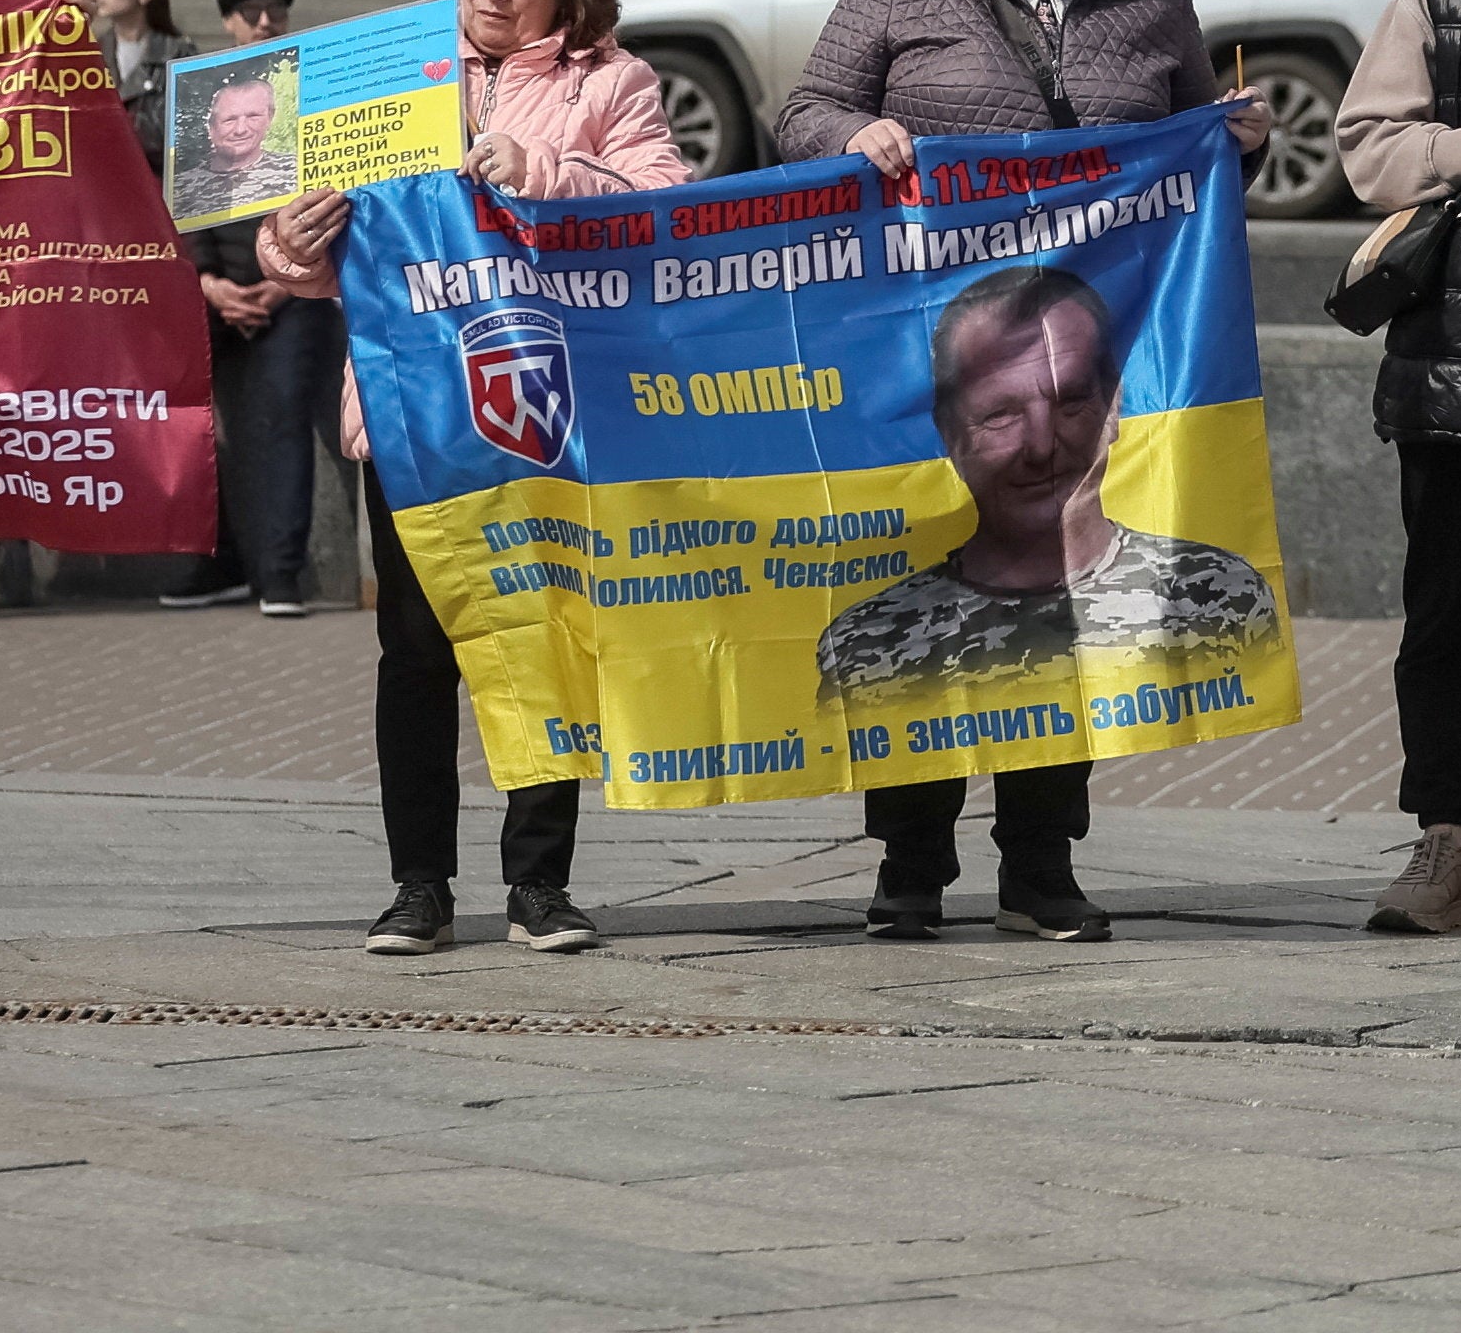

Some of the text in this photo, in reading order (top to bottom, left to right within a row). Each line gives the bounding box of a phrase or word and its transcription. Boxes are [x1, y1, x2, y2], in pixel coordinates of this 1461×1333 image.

[303, 101, 411, 136] 58 ОМПБр
[303, 119, 404, 151] Матюшко
[302, 145, 439, 181] Михайлович
[303, 134, 388, 166] Валерій
[670, 177, 862, 241] зниклий
[403, 170, 1197, 315] Матюшко Валерій Михайлович
[70, 286, 84, 303] 2
[89, 287, 151, 305] РОТА
[487, 318, 500, 328] AD
[629, 362, 843, 416] 58 ОМПБр
[64, 474, 125, 513] Яр
[629, 517, 757, 559] рідного
[769, 507, 912, 550] додому.
[589, 566, 751, 609] олимося.
[763, 549, 915, 590] Чекаємо.
[628, 728, 806, 784] зниклий
[848, 721, 890, 763] не
[905, 700, 1075, 757] значить
[1090, 665, 1255, 731] забутий.
